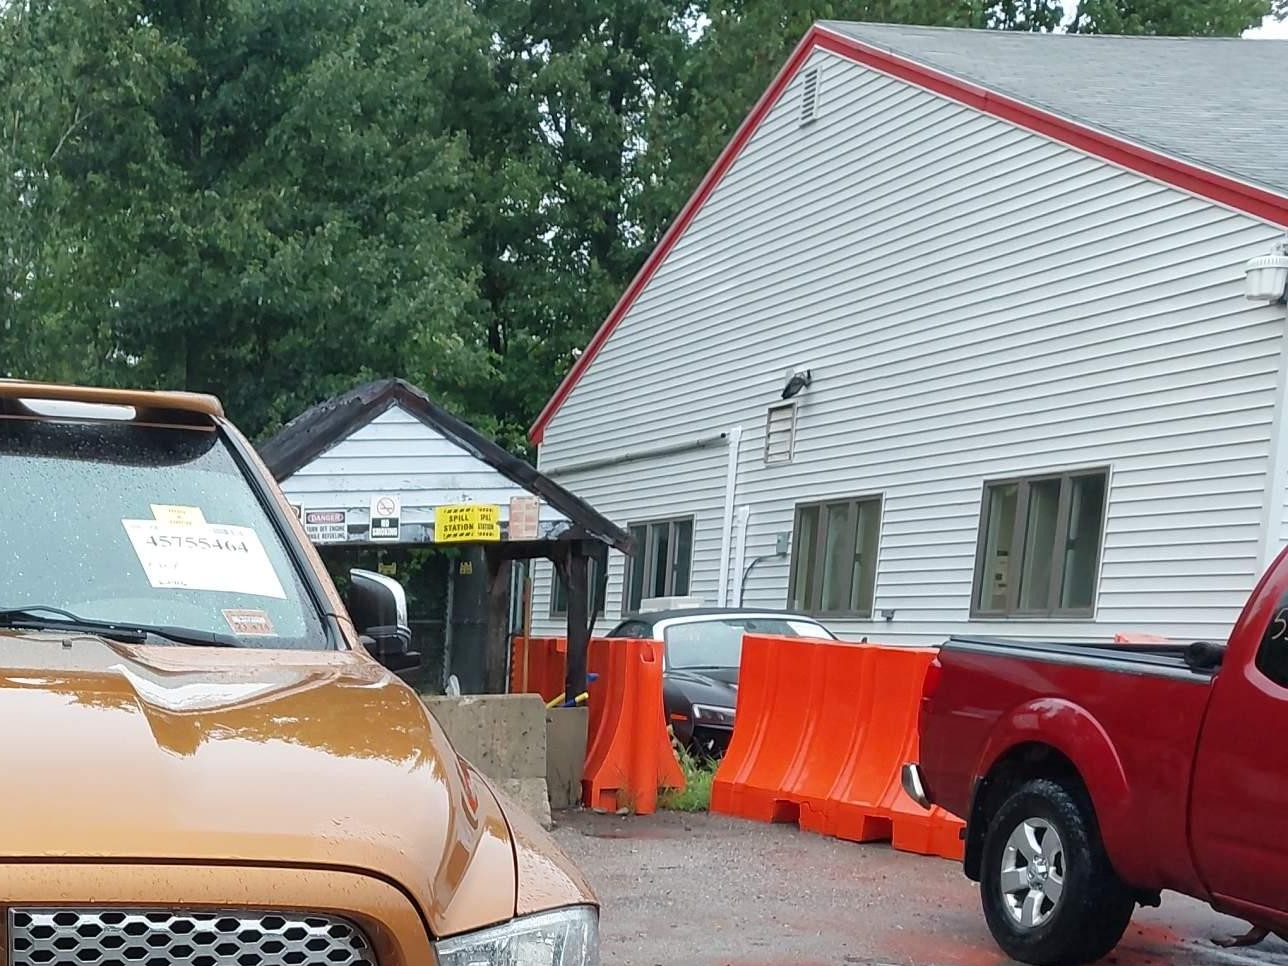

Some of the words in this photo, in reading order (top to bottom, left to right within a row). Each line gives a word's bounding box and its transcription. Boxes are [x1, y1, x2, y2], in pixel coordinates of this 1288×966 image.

[310, 513, 341, 522] DANGER
[448, 514, 469, 522] SPILL
[480, 513, 492, 521] SPILL
[380, 519, 390, 528] NO
[443, 523, 474, 532] STATION
[146, 535, 249, 553] 45755464
